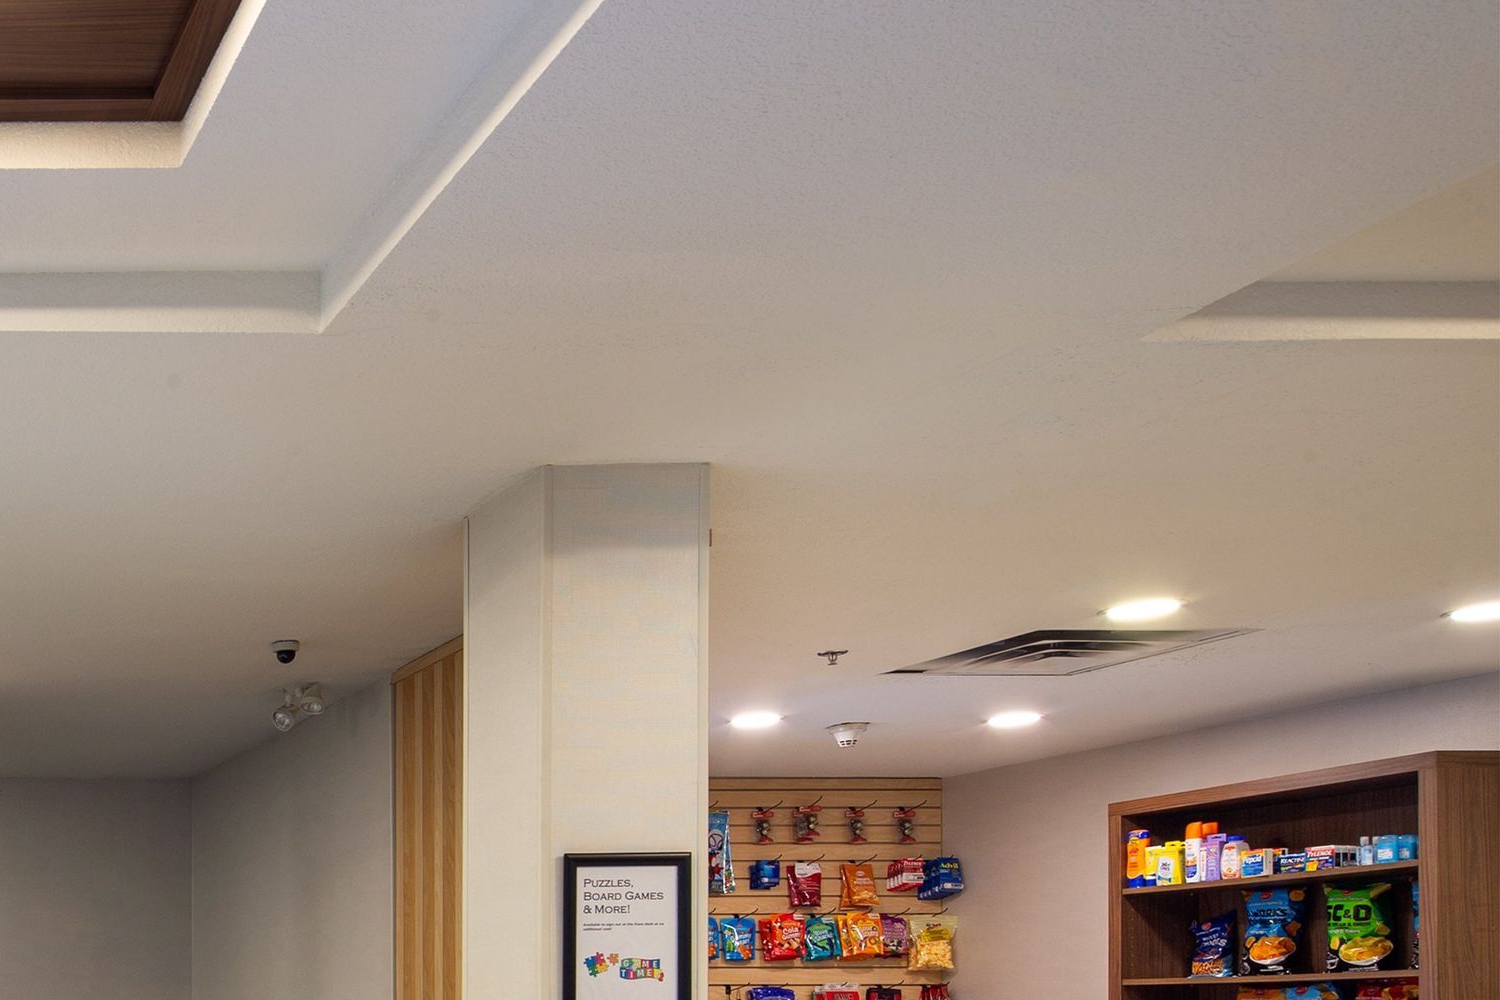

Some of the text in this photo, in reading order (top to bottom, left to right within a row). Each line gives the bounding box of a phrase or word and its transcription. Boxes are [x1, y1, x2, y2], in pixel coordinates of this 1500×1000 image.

[583, 891, 664, 901] BOARD GAMES
[583, 904, 631, 914] & MORE!
